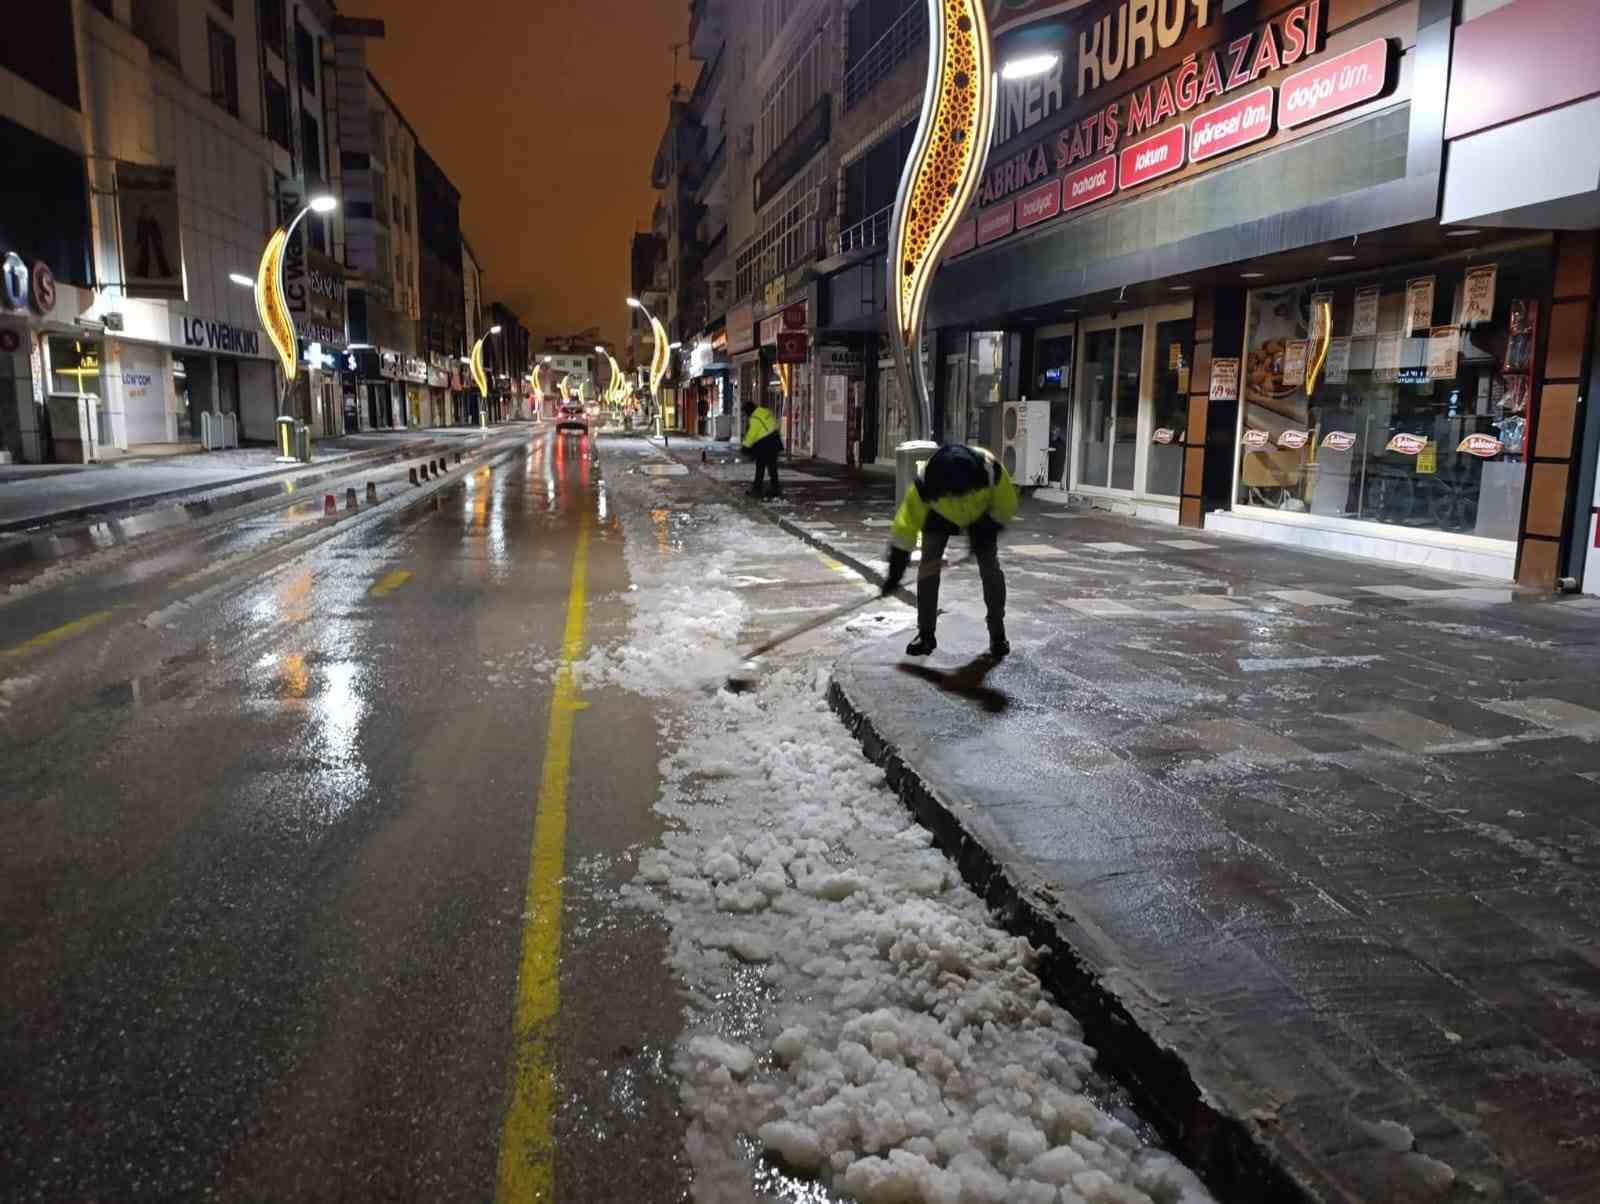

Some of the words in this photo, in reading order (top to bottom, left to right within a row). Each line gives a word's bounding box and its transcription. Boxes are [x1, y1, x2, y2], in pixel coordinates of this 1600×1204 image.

[1056, 104, 1119, 169] SATIŞ
[1127, 0, 1320, 137] MAĞAZASI
[1288, 72, 1337, 111] doğal
[1192, 110, 1242, 154] yöresel
[1135, 144, 1169, 172] lokum
[1072, 169, 1107, 197] baharat
[184, 317, 204, 346] LC
